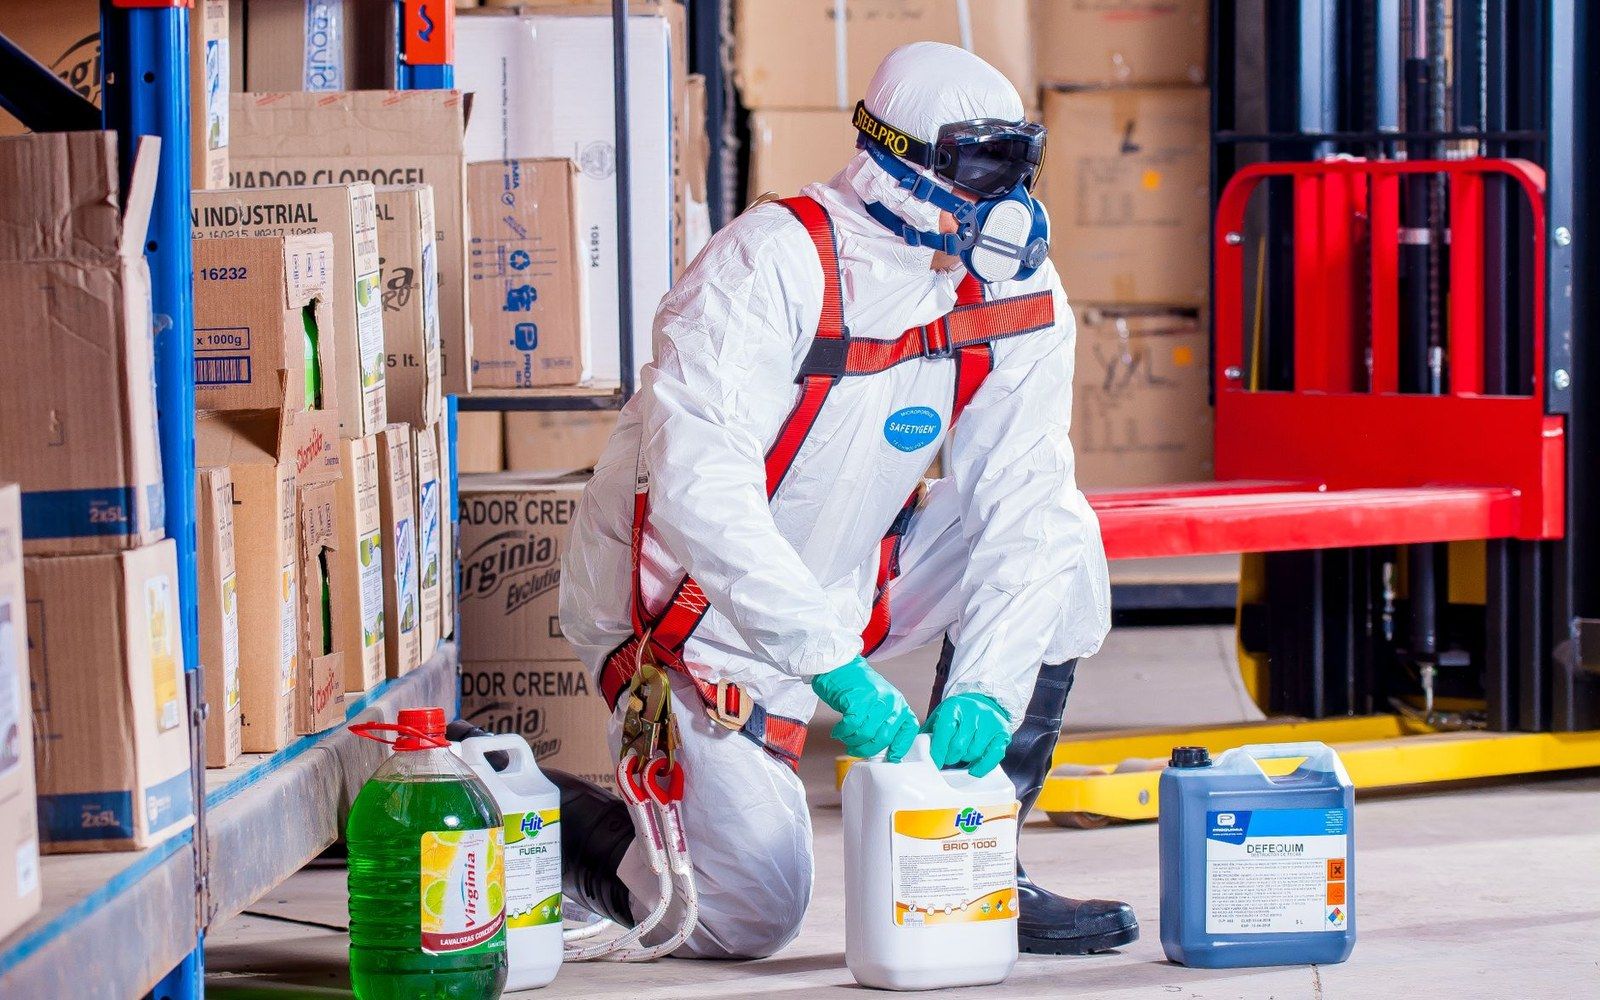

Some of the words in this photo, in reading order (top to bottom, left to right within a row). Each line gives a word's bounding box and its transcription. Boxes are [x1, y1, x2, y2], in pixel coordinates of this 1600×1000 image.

[855, 107, 908, 157] STEELPRO
[204, 203, 318, 227] INDUSTRIAL
[200, 267, 247, 281] 16232
[208, 334, 242, 347] 1000g
[387, 354, 397, 368] 5
[403, 353, 419, 367] lt.
[513, 671, 588, 697] CREMA
[521, 816, 543, 832] Hit
[955, 810, 984, 827] Hit
[519, 846, 548, 857] FUERA
[943, 842, 969, 852] BRIO
[971, 840, 997, 849] 1000
[1246, 843, 1304, 854] DEFEQUIM
[465, 851, 479, 928] Virginia
[440, 935, 474, 946] LAVALOZAS
